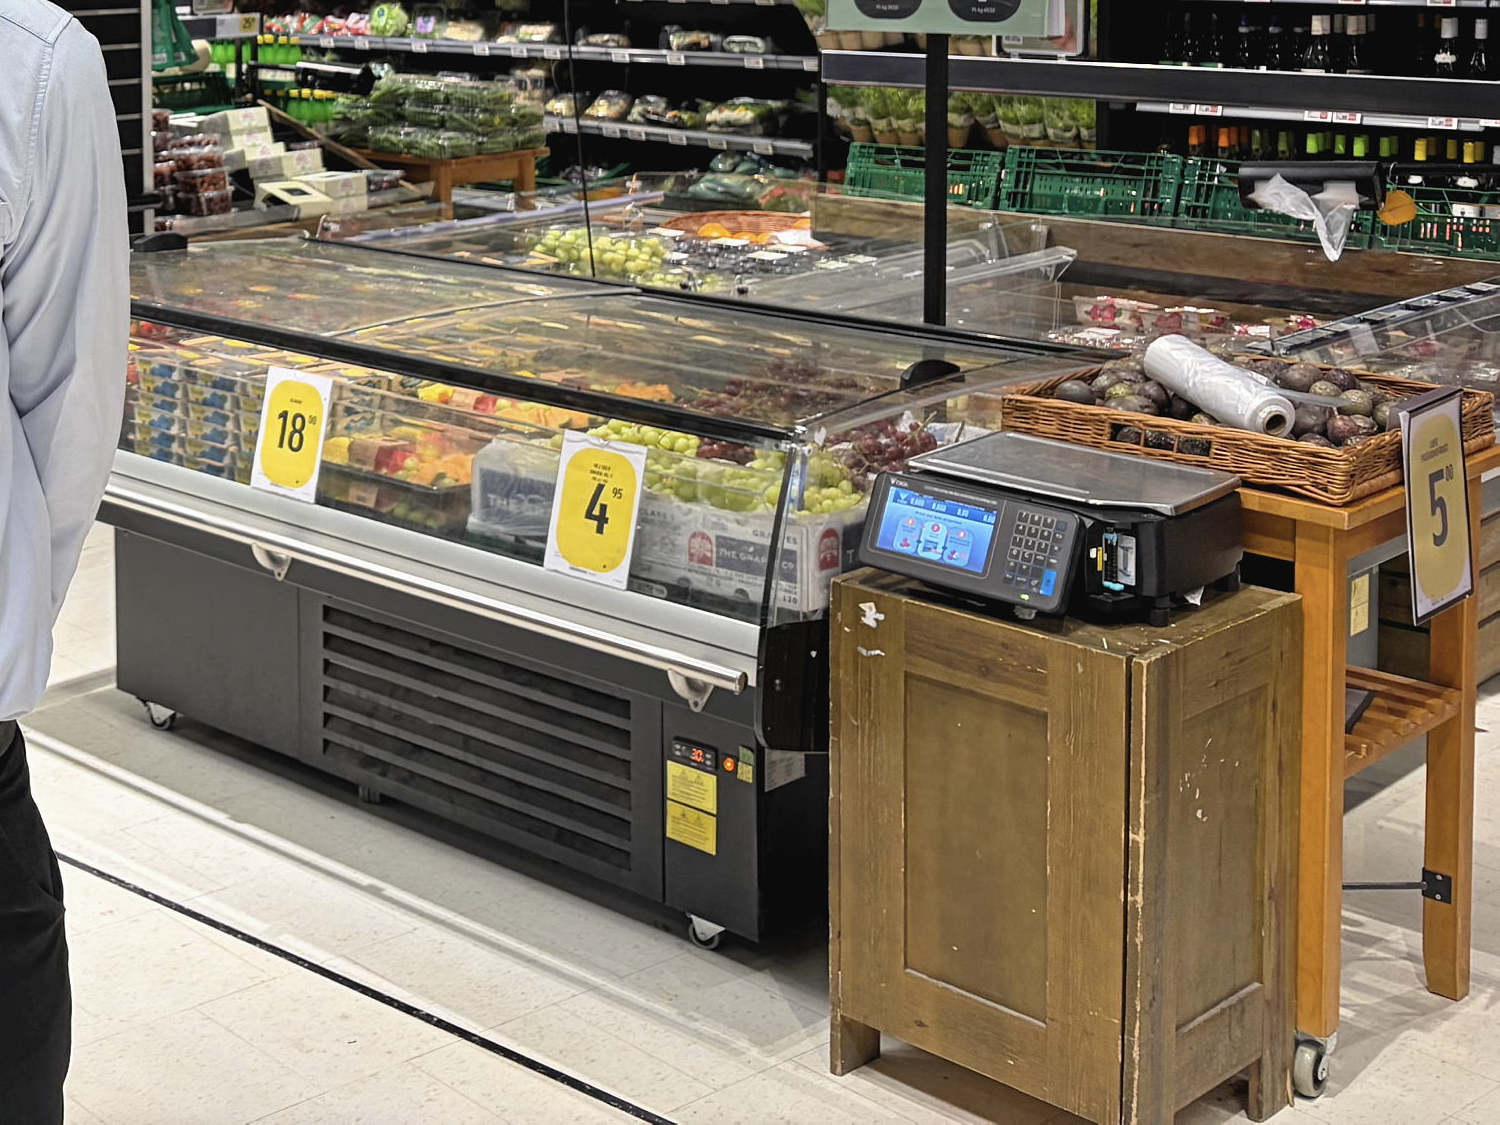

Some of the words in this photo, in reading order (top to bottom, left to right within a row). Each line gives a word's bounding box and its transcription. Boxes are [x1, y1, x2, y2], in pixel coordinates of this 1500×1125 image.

[277, 410, 306, 453] 18
[584, 483, 609, 536] 4
[612, 487, 624, 500] 95
[1428, 468, 1448, 547] 5
[752, 529, 798, 545] GRAES
